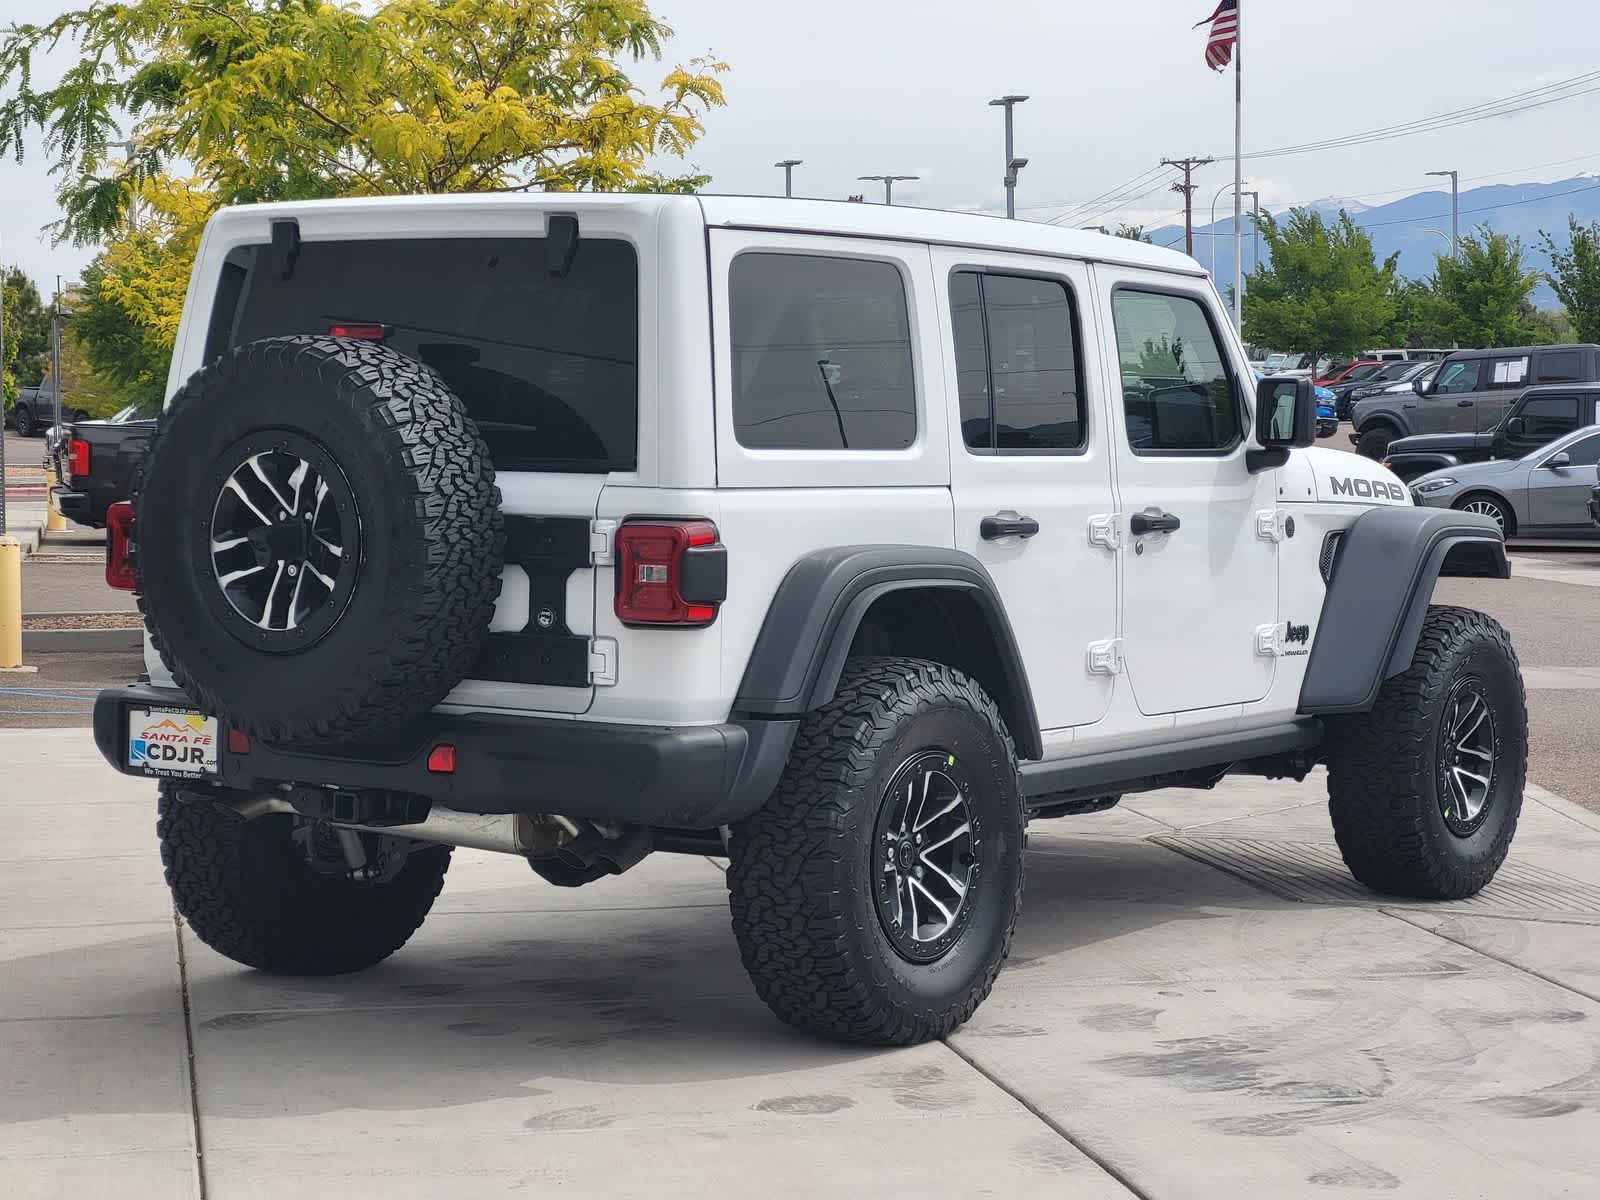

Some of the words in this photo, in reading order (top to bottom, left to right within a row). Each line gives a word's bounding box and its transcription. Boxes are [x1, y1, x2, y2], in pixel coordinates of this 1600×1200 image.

[1329, 476, 1405, 501] MOAB
[1285, 621, 1309, 645] Jeep
[140, 732, 188, 743] SANTA
[144, 767, 153, 775] We
[155, 768, 170, 776] Trust
[170, 769, 182, 777] You
[183, 771, 202, 779] Better
